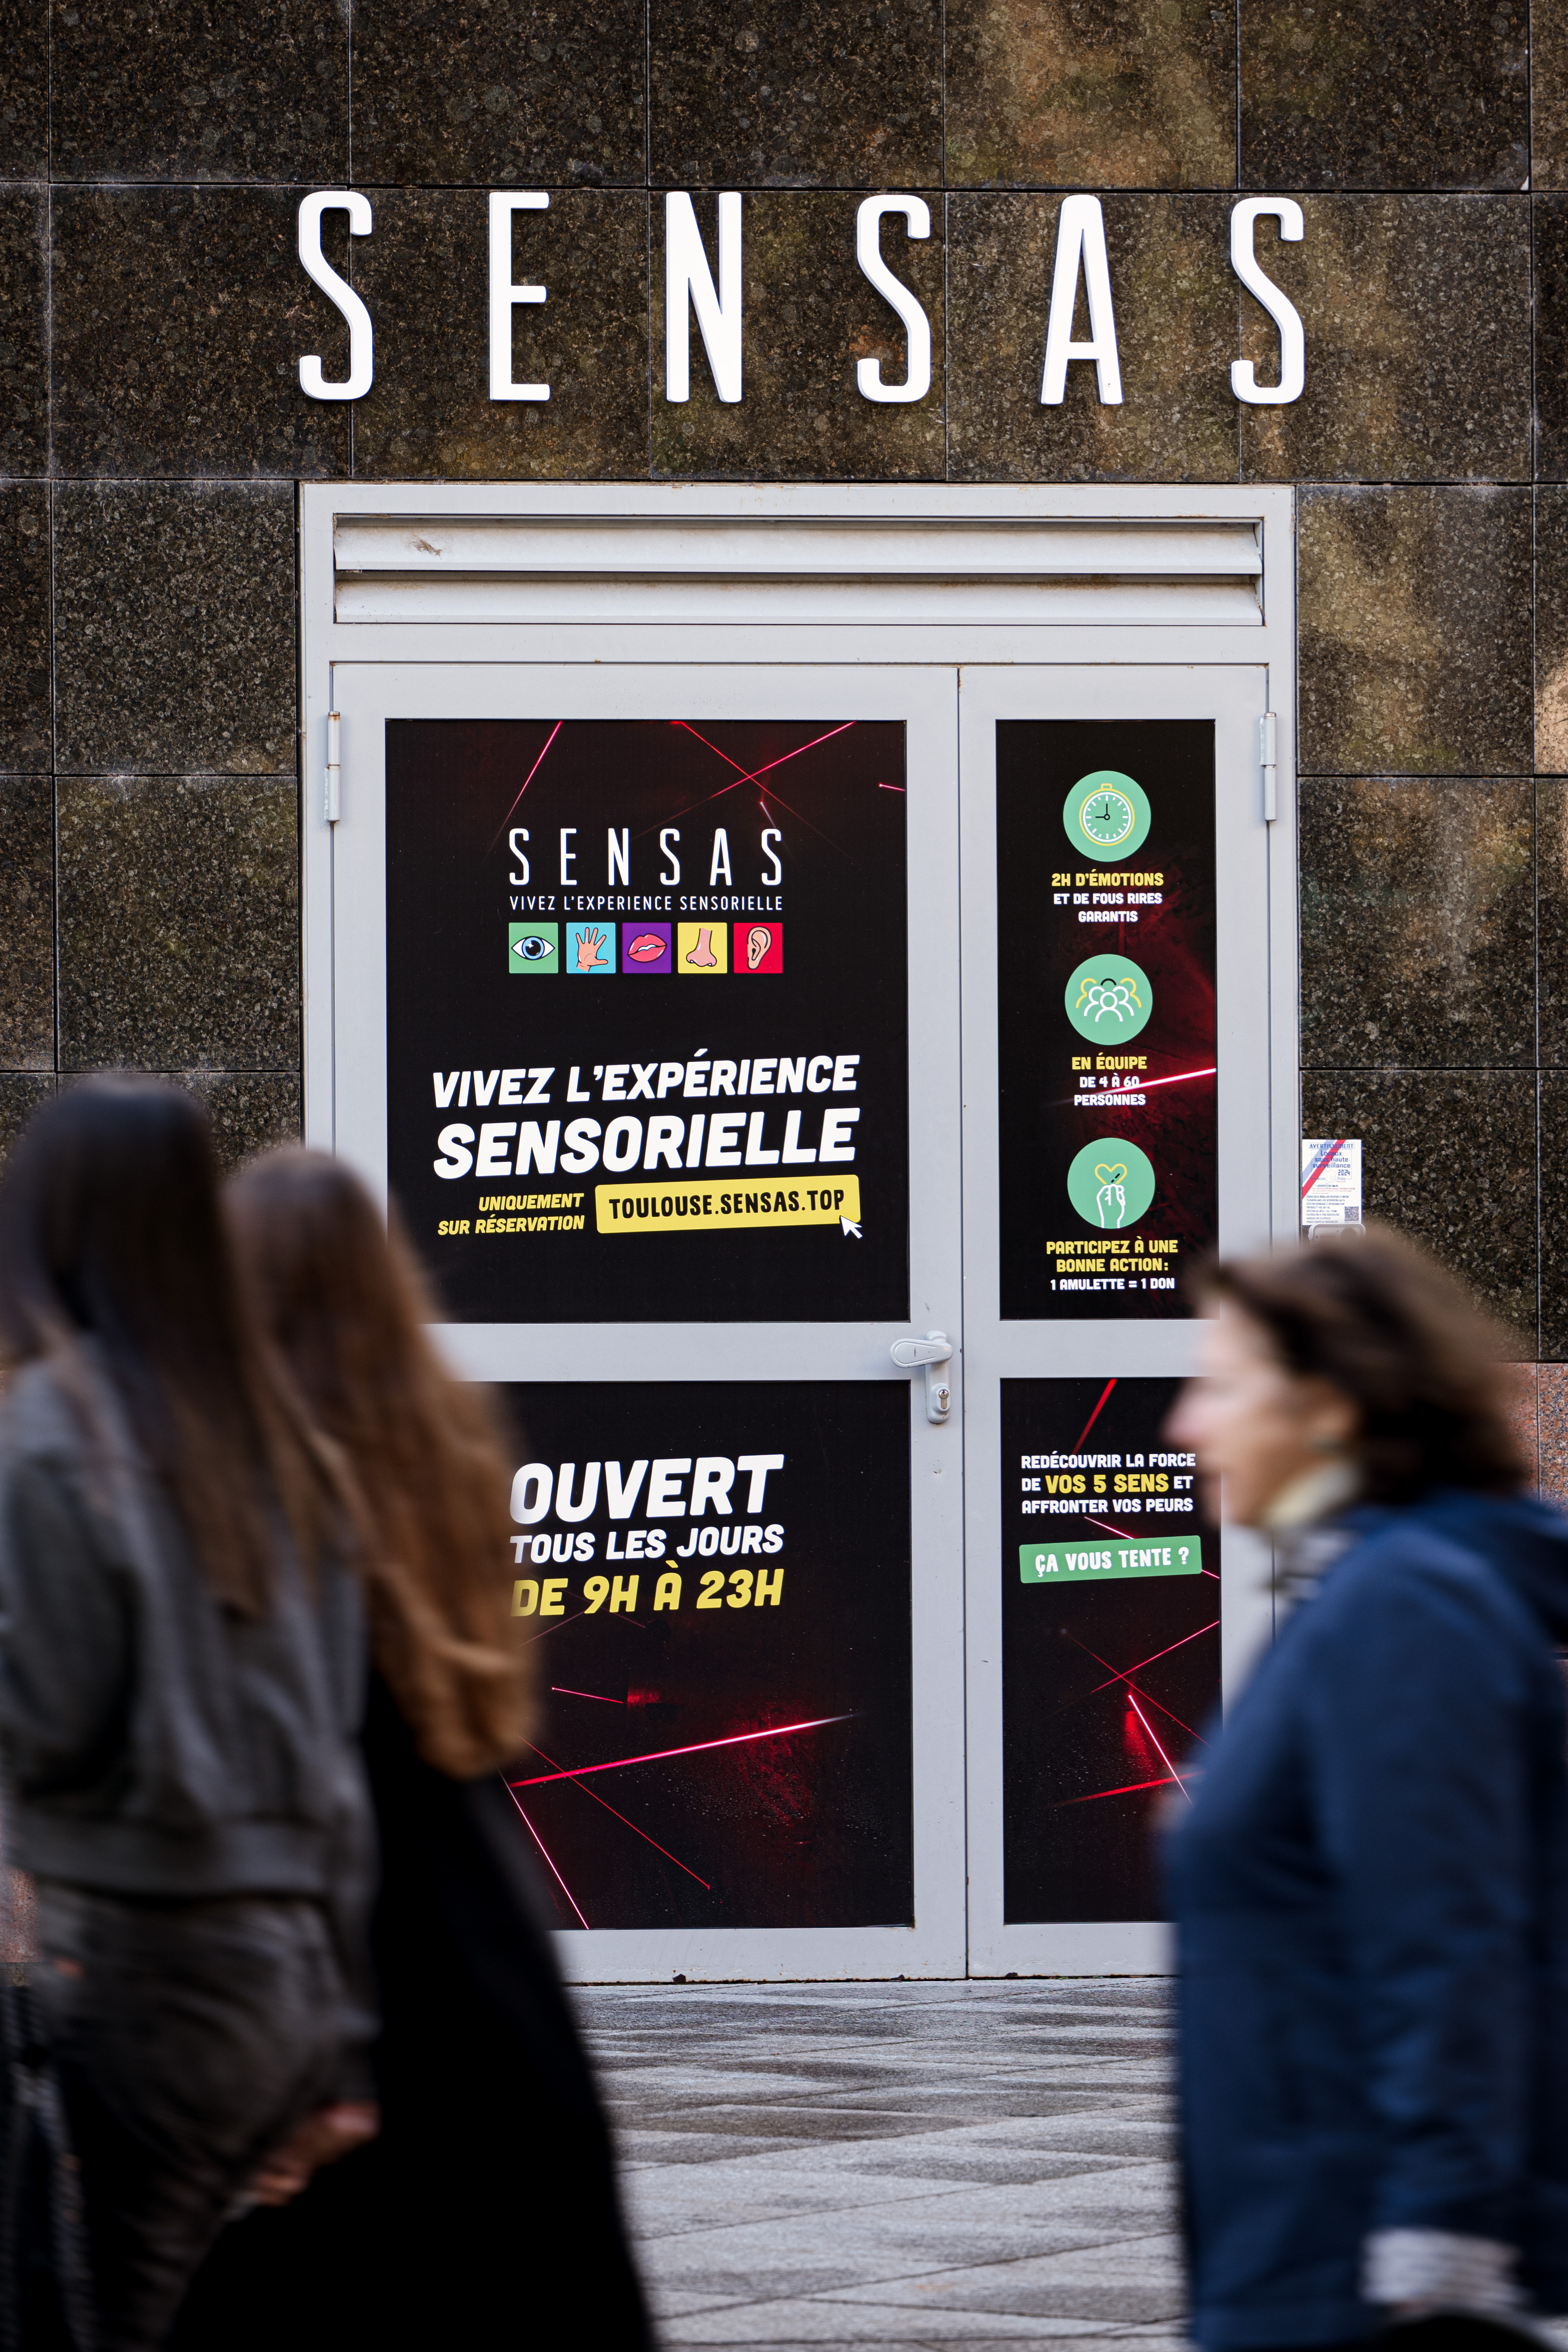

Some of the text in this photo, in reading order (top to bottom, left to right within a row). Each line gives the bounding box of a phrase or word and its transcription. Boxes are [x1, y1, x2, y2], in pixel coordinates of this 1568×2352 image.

[299, 191, 1304, 404] SENSAS
[510, 828, 781, 886] SENSAS
[1052, 869, 1163, 886] 2H D'ÉMOTIONS
[510, 896, 782, 910] VIVEZ L'EXPERIENCE SENSORIELLE
[1054, 893, 1162, 904] ET DE FOUS RIRES
[1078, 911, 1138, 922] GARANTIS
[1072, 1053, 1147, 1070] EN ÉQUIPE
[433, 1049, 860, 1107] VIVEZ L'EXPÉRIENCE
[1080, 1073, 1139, 1087] DE 4 À 60
[1074, 1094, 1146, 1105] PERSONNES
[434, 1108, 860, 1179] SENSORIELLE
[479, 1193, 584, 1211] UNIQUEMENT
[609, 1190, 844, 1219] TOULOUSE.SENSAS.TOP
[438, 1214, 584, 1235] SUR RÉSERVATION
[1047, 1236, 1178, 1254] PARTICIPEZ À UNE
[1057, 1258, 1168, 1272] BONNE ACTION:
[1051, 1279, 1056, 1290] 1
[1060, 1279, 1125, 1290] AMULETTE
[1141, 1278, 1146, 1289] 1
[1151, 1278, 1174, 1289] DON
[1022, 1451, 1196, 1468] REDÉCOUVRIR LA FORCE
[510, 1454, 784, 1524] OUVERT
[1022, 1474, 1193, 1493] DE VOS 5 SENS ET
[1022, 1498, 1193, 1514] AFFRONTER VOS PEURS
[510, 1524, 784, 1563] TOUS LES JOURS
[1035, 1547, 1189, 1577] ÇA VOUS TENTE ?
[511, 1560, 784, 1616] DE 9H À 23H
